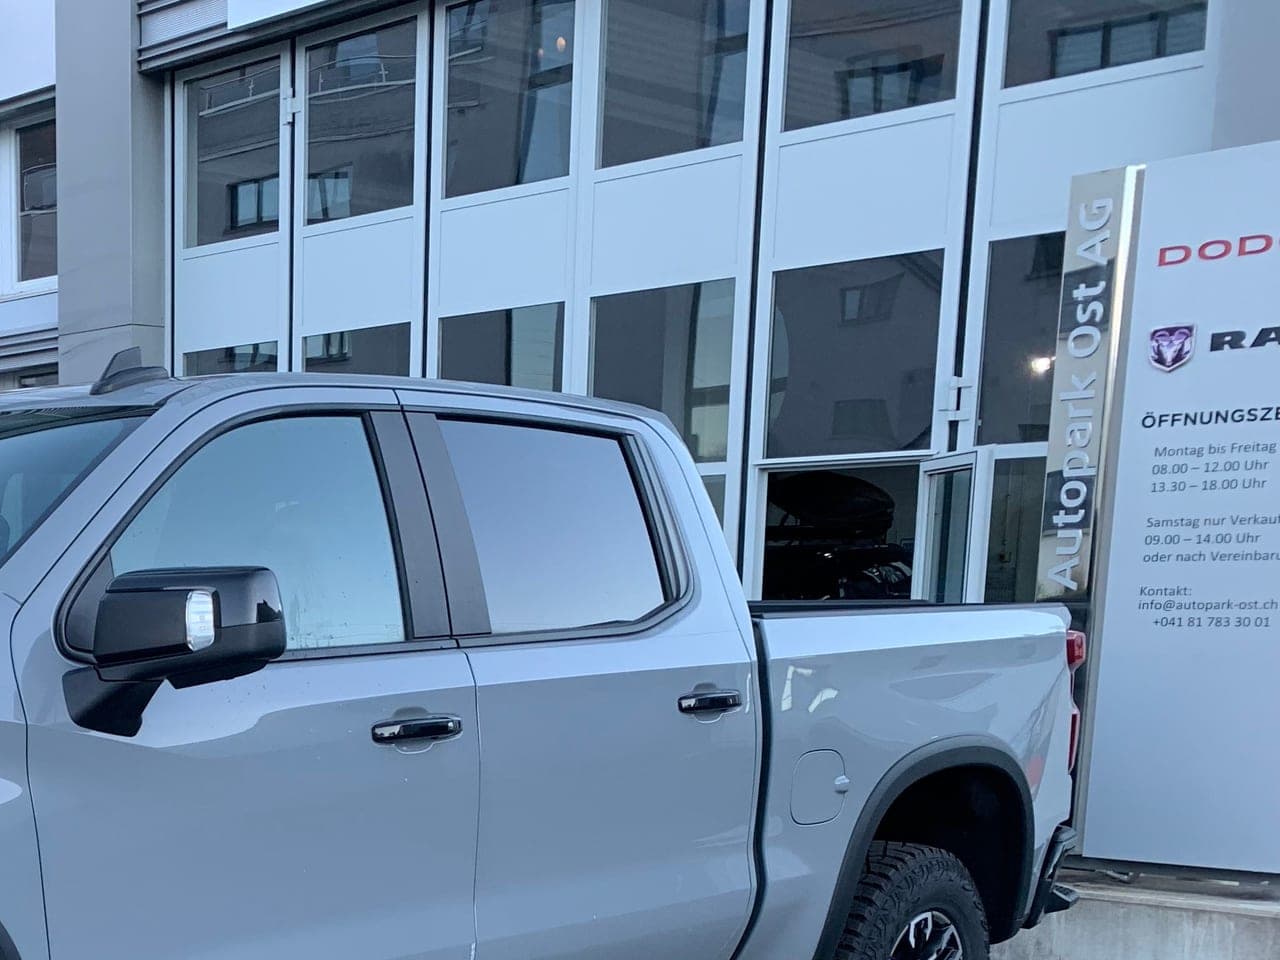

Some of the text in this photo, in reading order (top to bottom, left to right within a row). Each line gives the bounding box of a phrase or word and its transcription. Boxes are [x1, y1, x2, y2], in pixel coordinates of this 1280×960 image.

[1157, 234, 1280, 267] DOD
[1209, 326, 1280, 352] RA
[1048, 197, 1113, 591] Autopark Ost AG
[1154, 442, 1277, 458] Montag bis Freitag
[1151, 463, 1188, 475] 08.00
[1204, 461, 1240, 473] 12.00
[1244, 459, 1269, 471] Uhr
[1151, 481, 1186, 493] 13.30
[1201, 479, 1238, 491] 18.00
[1242, 478, 1267, 489] Uhr
[1146, 517, 1200, 529] Samstag
[1203, 517, 1227, 527] nur
[1144, 534, 1181, 546] 09.00
[1195, 533, 1232, 545] 14.00
[1236, 532, 1261, 544] Uhr
[1143, 552, 1172, 563] oder
[1175, 551, 1206, 562] nach
[1139, 586, 1192, 597] Kontakt:
[1138, 599, 1278, 612] info@autopark-ost.ch
[1152, 616, 1271, 628] +041 81 783 30 01
